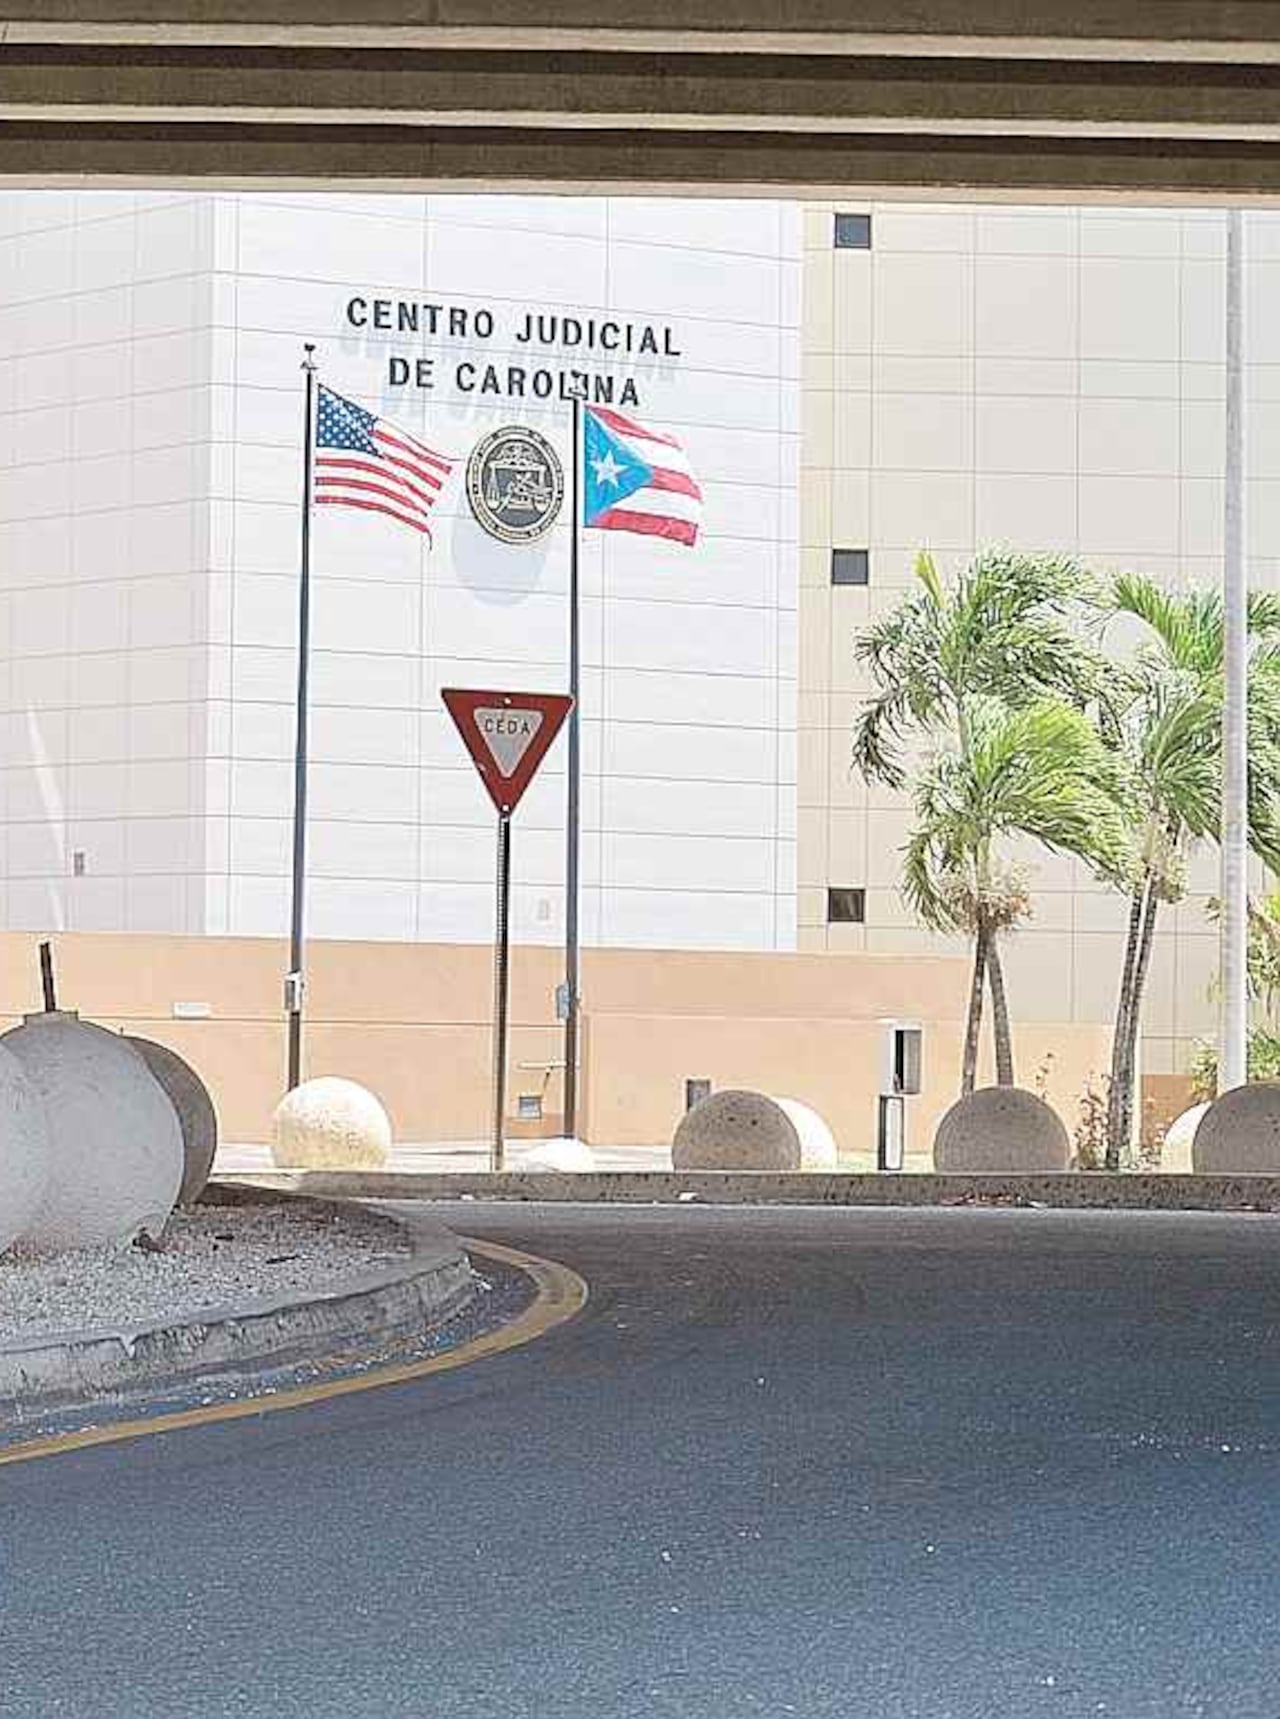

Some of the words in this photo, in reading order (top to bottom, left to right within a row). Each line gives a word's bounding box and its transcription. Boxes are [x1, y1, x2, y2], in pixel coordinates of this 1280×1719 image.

[346, 297, 494, 338] CENTRO
[516, 314, 681, 355] JUDICIAL
[389, 357, 434, 388] DE
[456, 362, 639, 406] CAROLINA
[484, 718, 531, 735] CEDA
